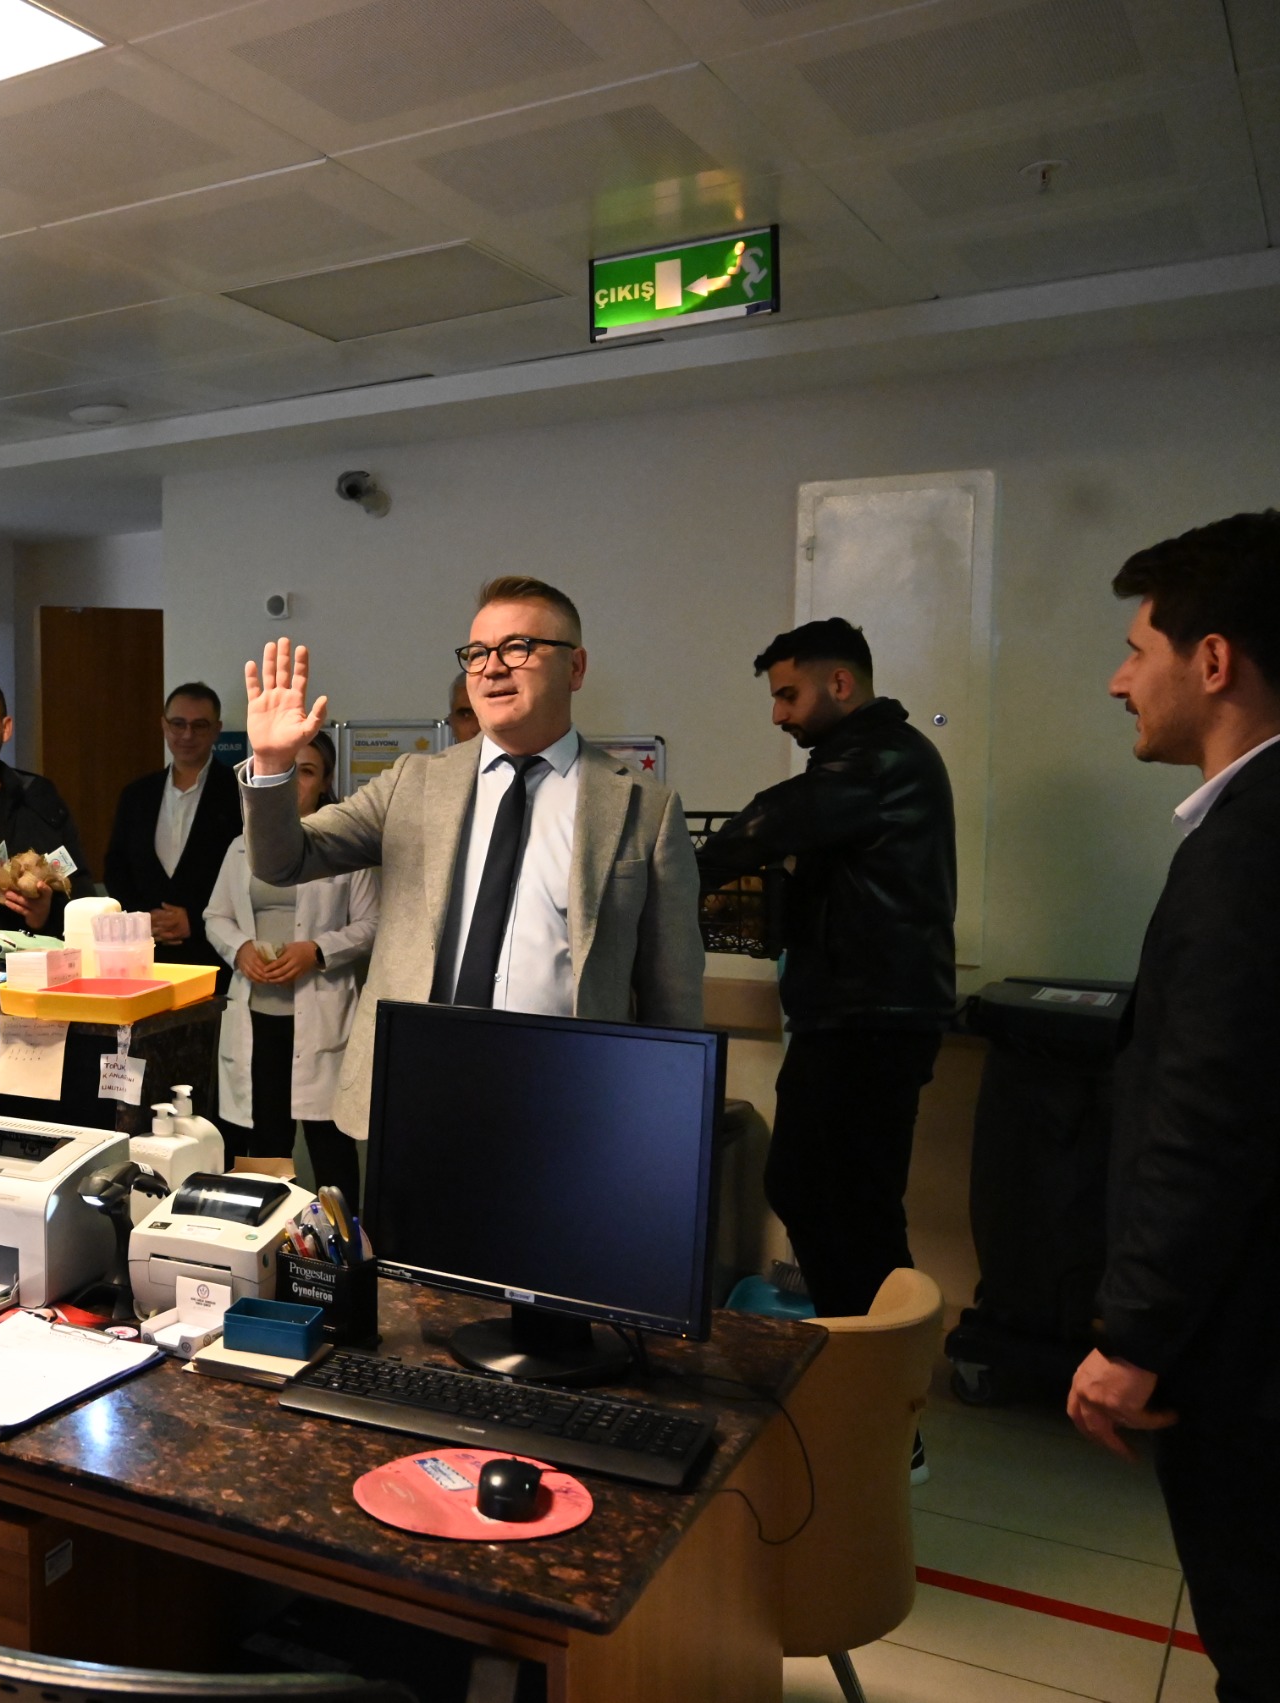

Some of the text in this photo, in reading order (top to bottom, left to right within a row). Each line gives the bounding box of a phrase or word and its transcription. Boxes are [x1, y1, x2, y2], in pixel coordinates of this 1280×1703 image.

[595, 281, 655, 309] ÇIKIŞ
[104, 1062, 126, 1071] TOPUK
[289, 1261, 336, 1284] Progestan
[292, 1282, 333, 1303] Gynoferon
